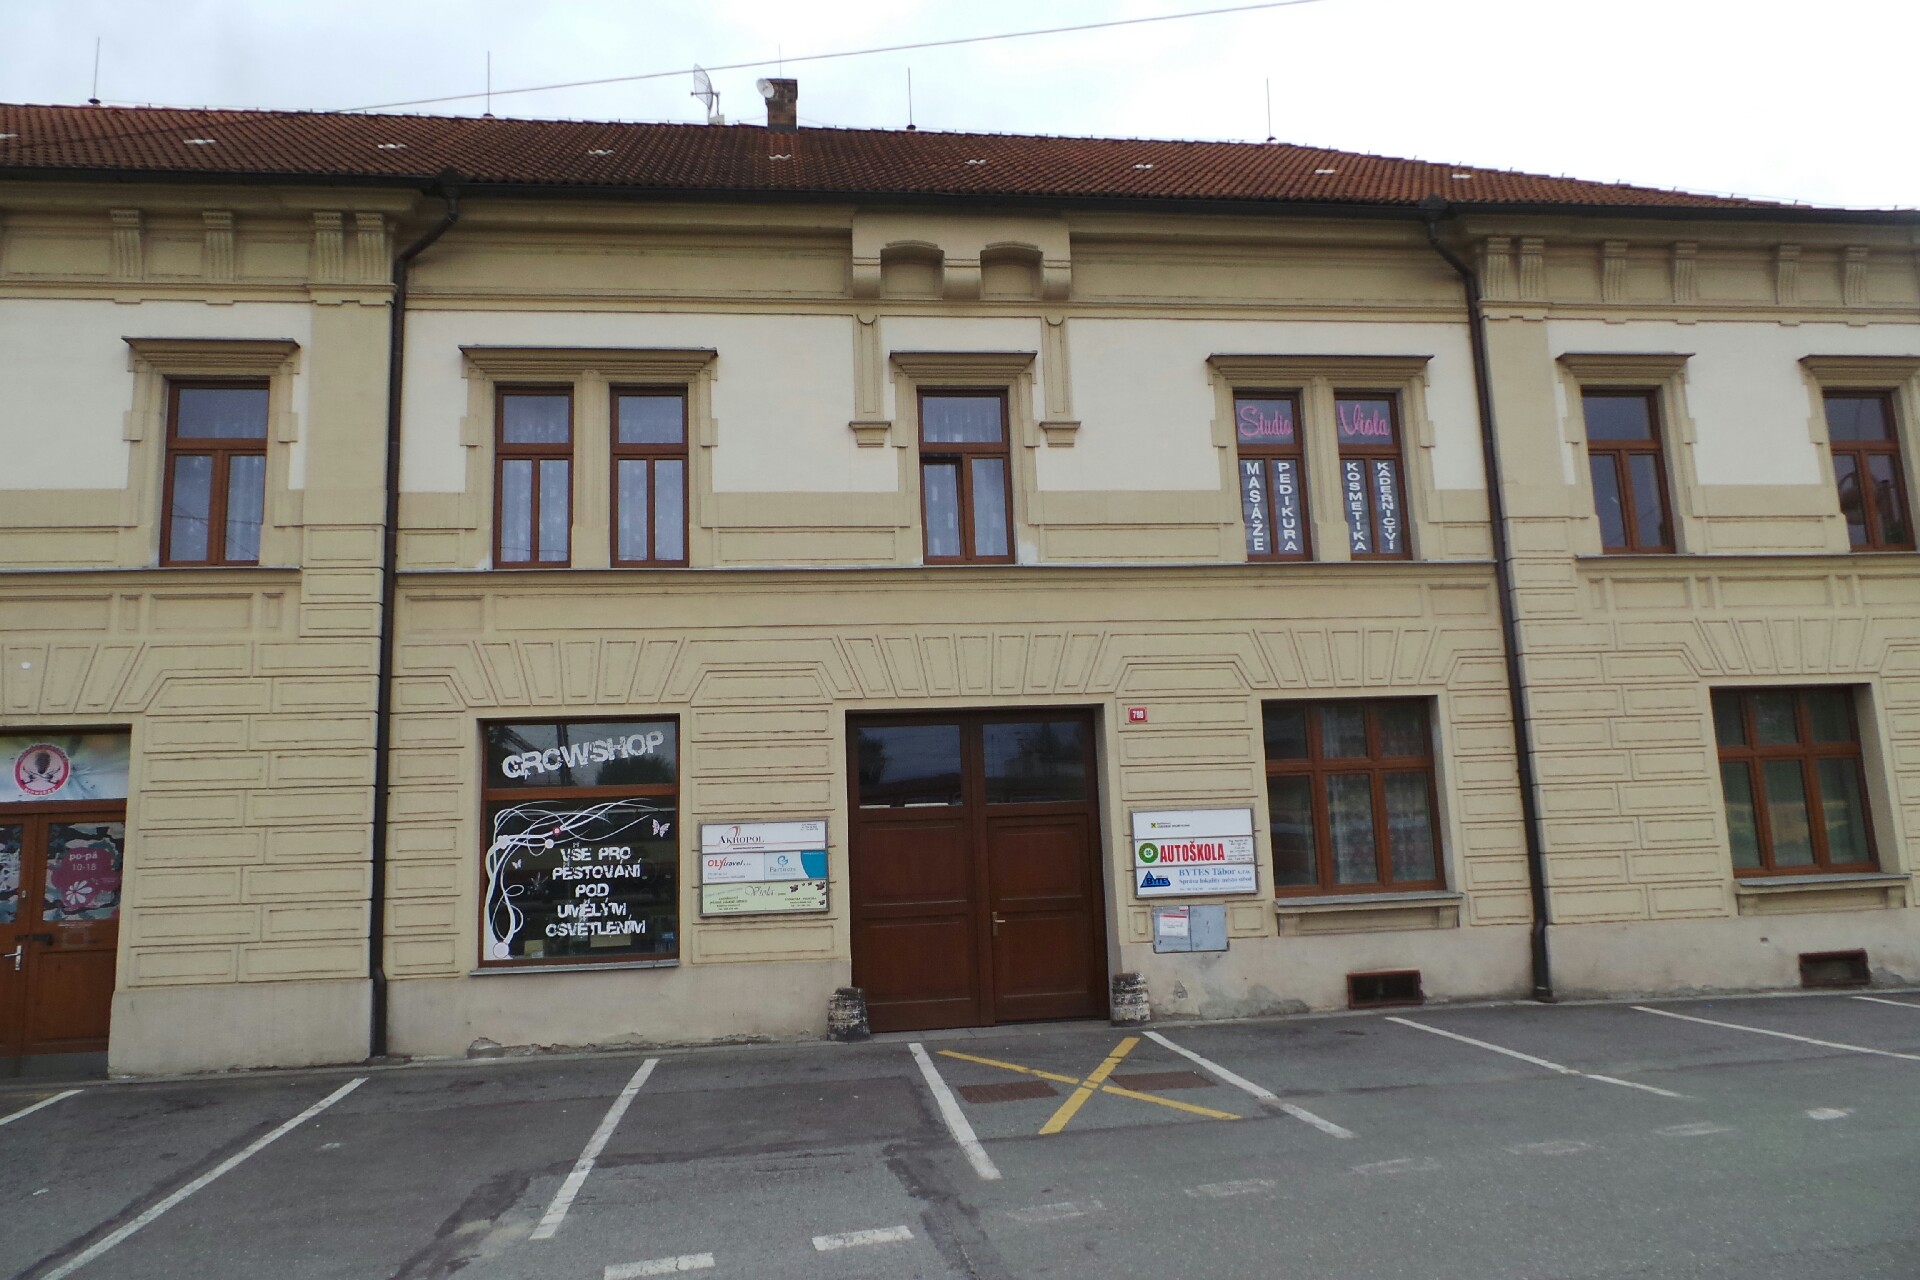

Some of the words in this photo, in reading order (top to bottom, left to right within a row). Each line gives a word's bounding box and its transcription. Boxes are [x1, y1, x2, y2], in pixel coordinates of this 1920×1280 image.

[1239, 405, 1294, 437] Studio
[1339, 403, 1391, 436] Viola
[1246, 462, 1265, 551] MASÁŽE
[1277, 462, 1298, 552] PEDIKURA
[1347, 462, 1367, 551] KOSMETIKA
[501, 730, 664, 780] GROWSHOP
[69, 851, 98, 861] po-pá
[560, 842, 592, 861] VŠE
[598, 846, 632, 861] PRO
[1160, 840, 1225, 863] AUTOŠKOLA
[72, 863, 97, 871] 10-18
[552, 857, 642, 880] PĚSTOVÁNÍ
[1178, 868, 1211, 876] BYTES
[1212, 867, 1236, 876] Tábor
[575, 883, 610, 898] POD
[744, 885, 775, 896] Viola
[557, 897, 627, 918] UMĚLÝM
[545, 914, 646, 937] OSVĚTLENÍM
